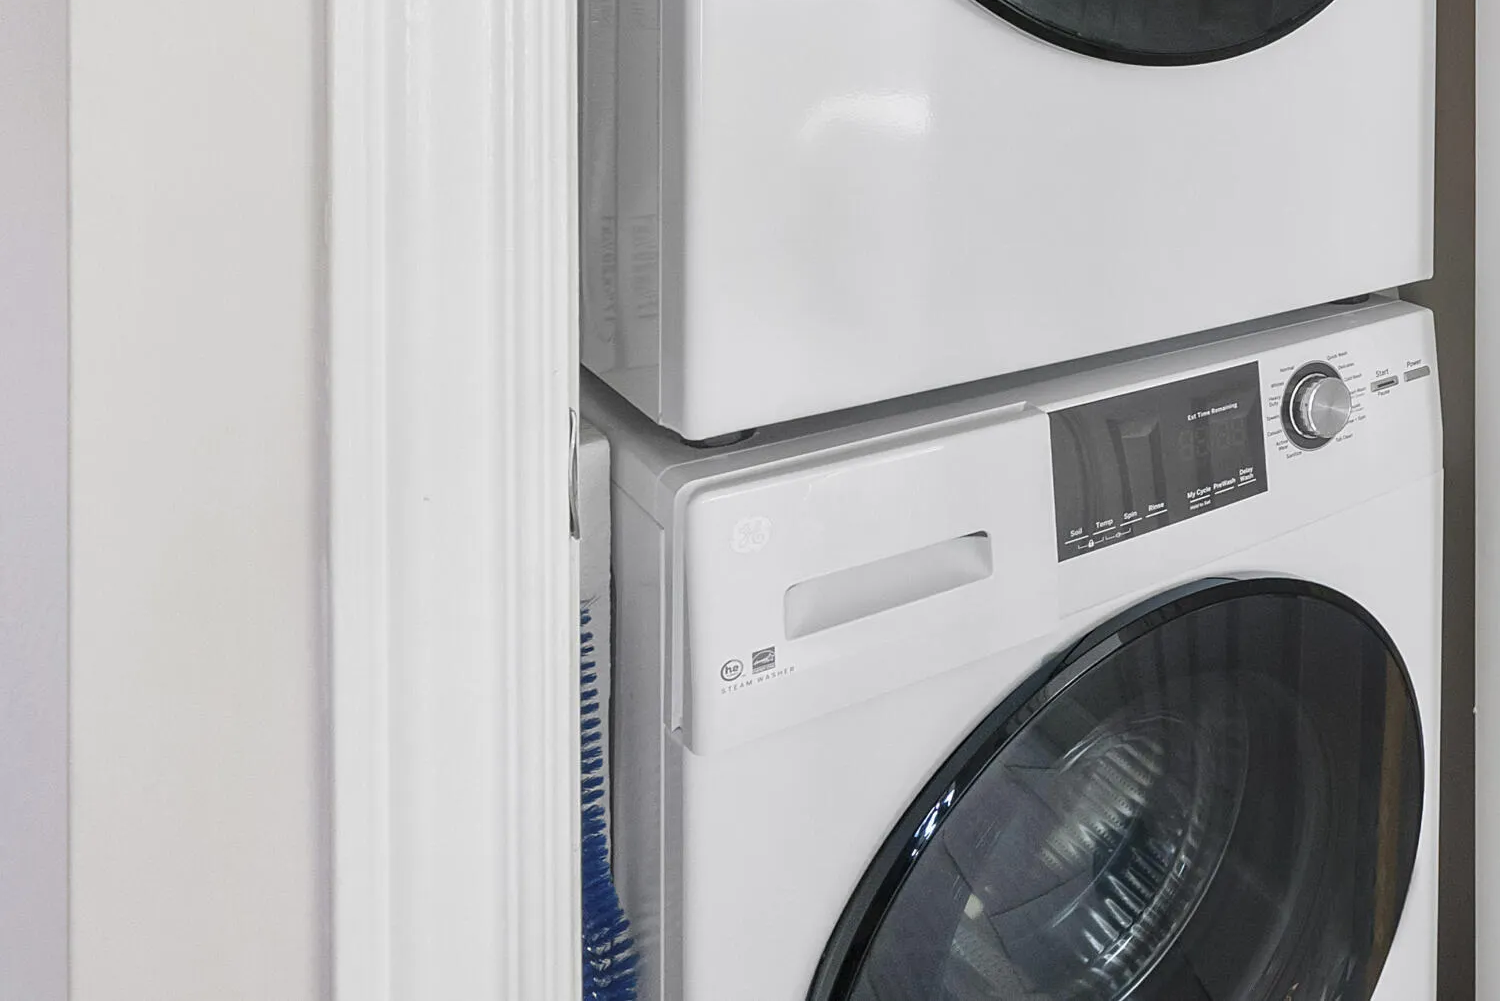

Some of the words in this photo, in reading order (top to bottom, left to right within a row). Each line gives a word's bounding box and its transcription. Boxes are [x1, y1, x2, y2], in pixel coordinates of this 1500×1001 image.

[1406, 359, 1422, 368] Power
[1375, 368, 1389, 378] Start
[1187, 413, 1197, 421] Est
[1197, 410, 1211, 419] Time
[1211, 402, 1238, 414] Remaining
[1239, 466, 1254, 476] Delay
[1187, 491, 1196, 499] My
[1196, 486, 1211, 496] Cycle
[1148, 502, 1165, 512] Rinse
[1123, 510, 1138, 520] Spin
[1095, 518, 1114, 529] Temp
[1070, 527, 1083, 537] Soil
[721, 679, 753, 694] STEAM
[757, 666, 795, 683] WASHER
